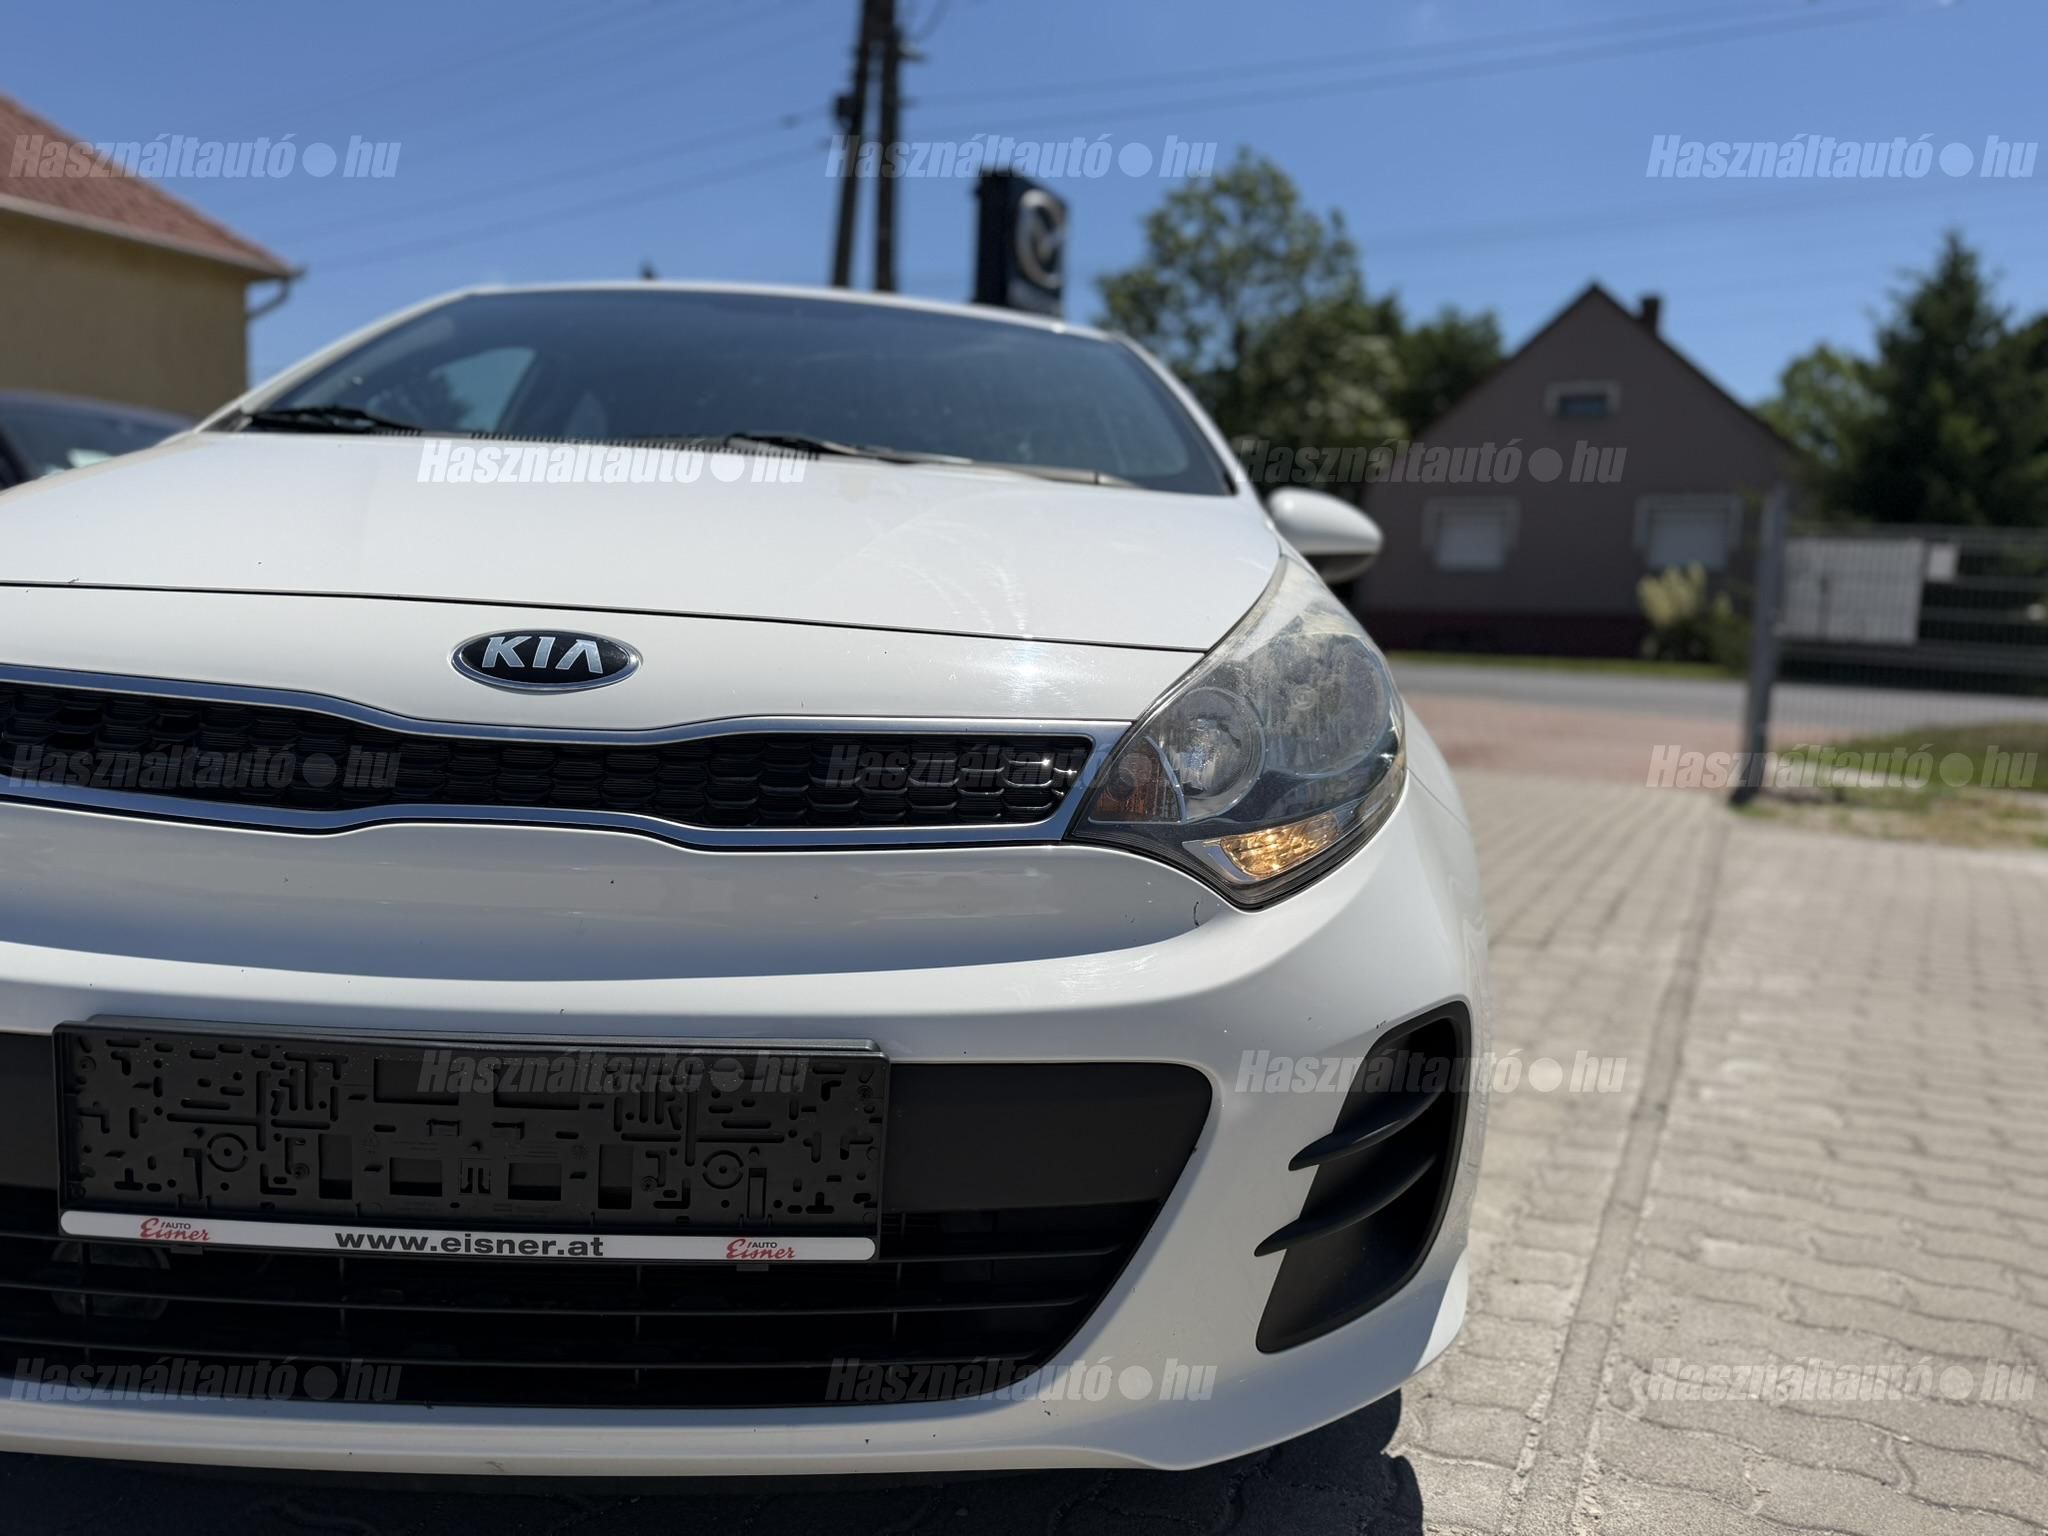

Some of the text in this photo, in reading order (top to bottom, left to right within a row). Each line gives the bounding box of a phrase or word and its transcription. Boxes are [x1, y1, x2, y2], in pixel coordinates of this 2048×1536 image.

[481, 635, 604, 675] KIA
[140, 1217, 210, 1241] Eisner
[335, 1232, 604, 1257] www.eisner.at
[726, 1238, 796, 1260] Eisner
